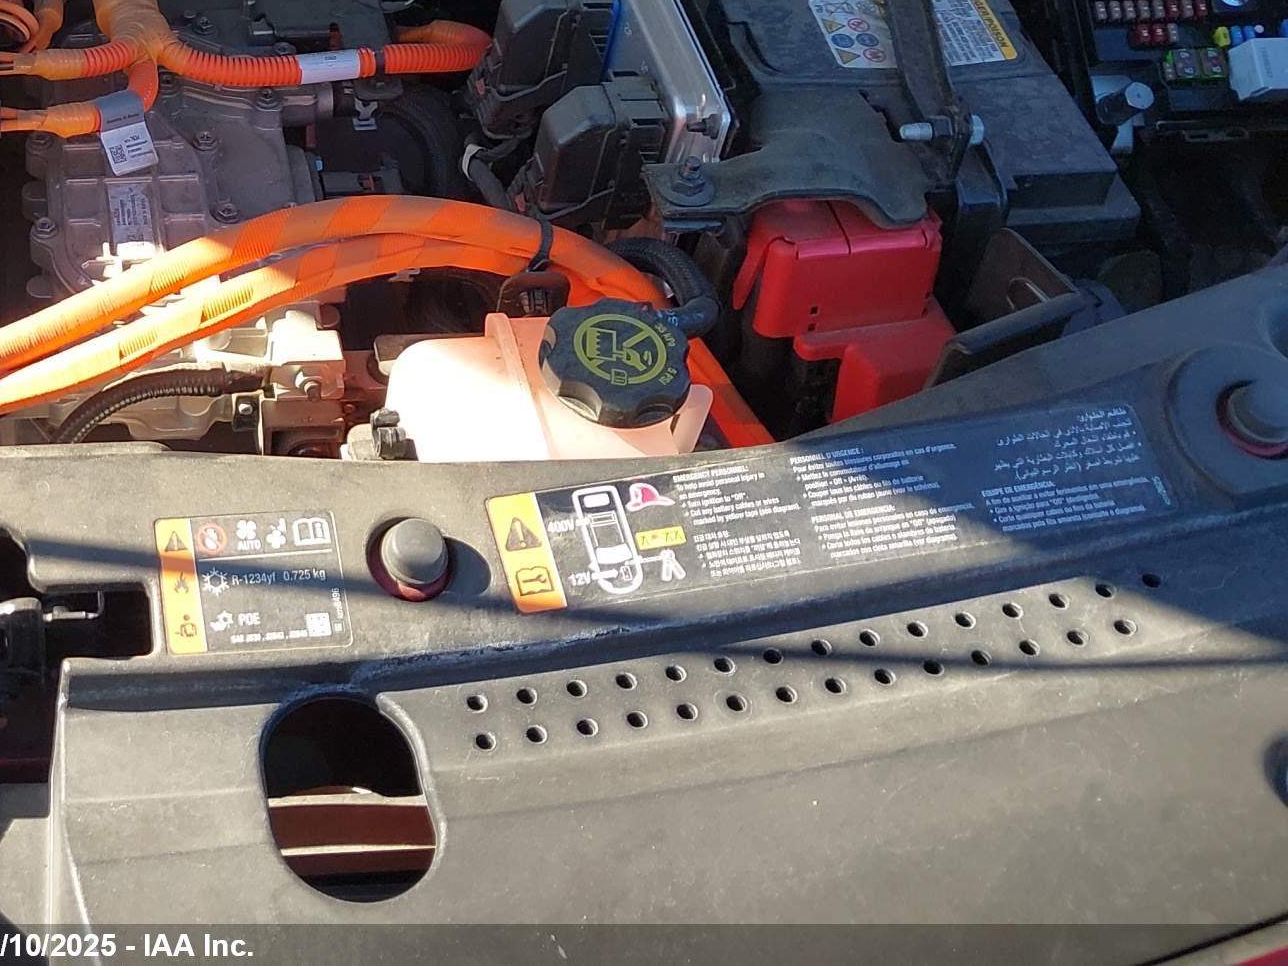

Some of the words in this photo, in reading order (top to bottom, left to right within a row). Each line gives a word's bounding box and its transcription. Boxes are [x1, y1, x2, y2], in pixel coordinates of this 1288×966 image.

[548, 518, 574, 533] 400V
[237, 540, 262, 551] AUTO
[231, 572, 276, 586] R-1234yf
[282, 569, 311, 581] 0.725
[313, 568, 326, 581] kg
[568, 571, 590, 586] 12V
[237, 612, 261, 626] POE
